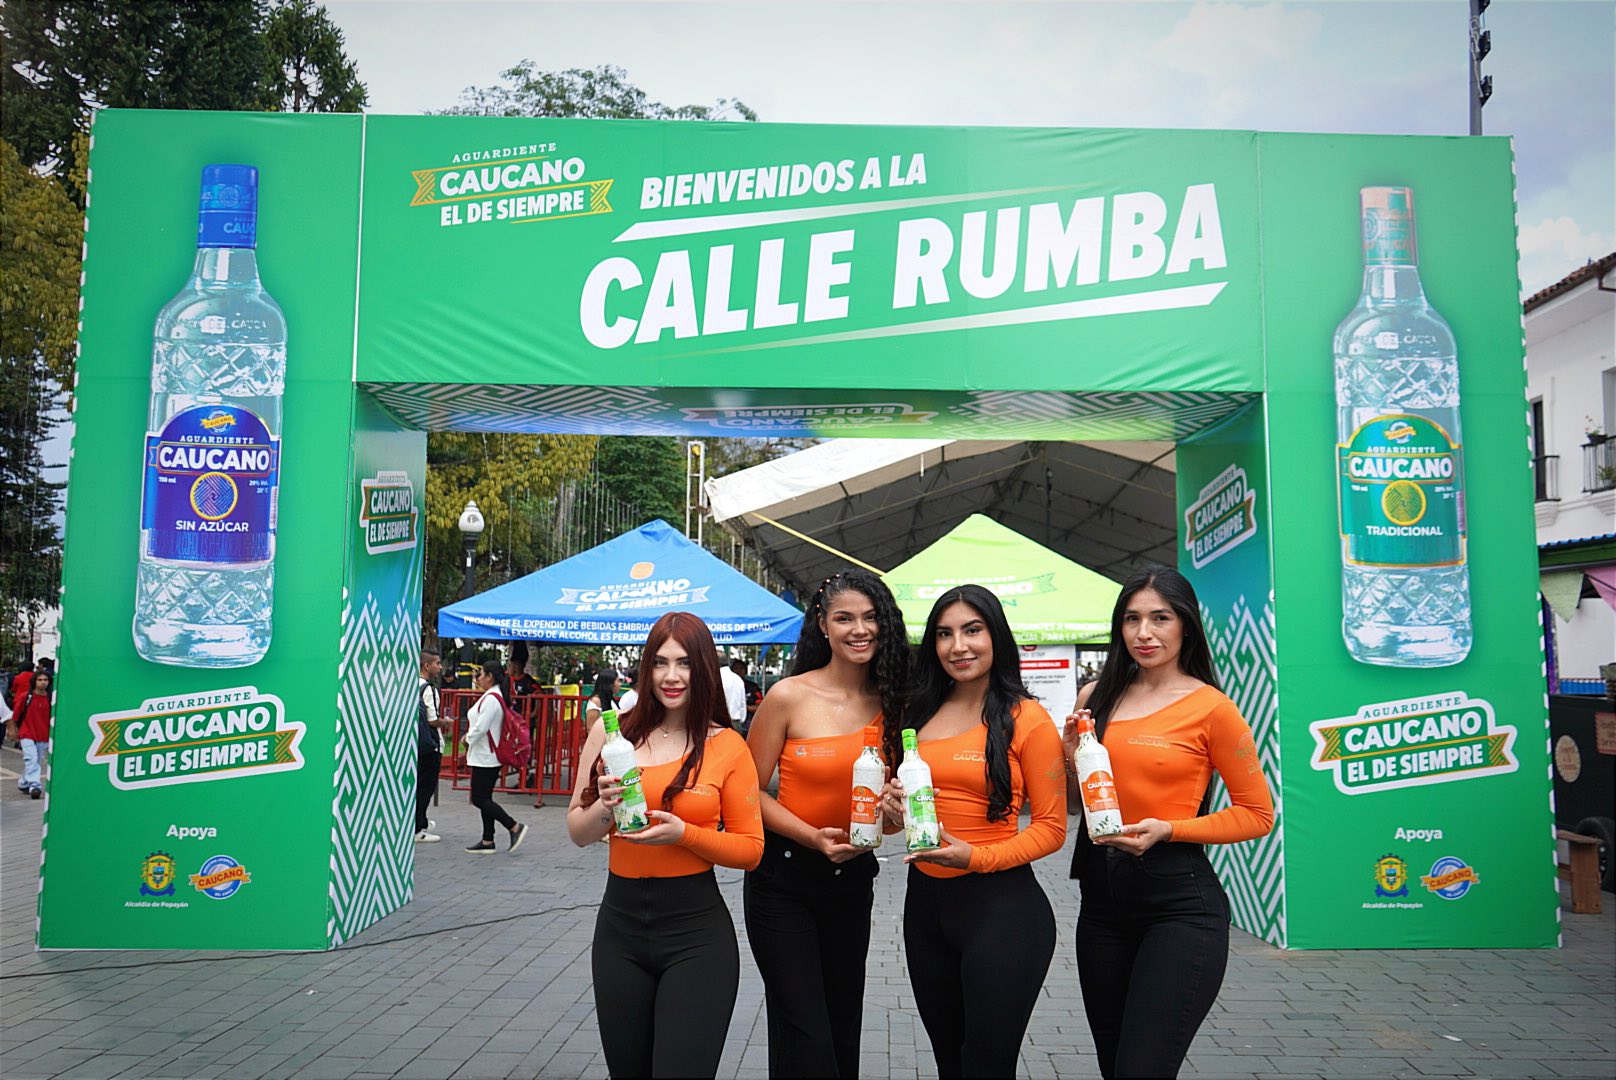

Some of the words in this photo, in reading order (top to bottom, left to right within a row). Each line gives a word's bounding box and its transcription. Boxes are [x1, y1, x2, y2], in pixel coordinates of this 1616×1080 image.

[452, 142, 557, 164] AGUARDIENTE
[440, 157, 586, 197] CAUCANO
[640, 159, 855, 210] BIENVENIDOS
[859, 156, 883, 191] A
[889, 153, 928, 186] LA
[440, 205, 463, 227] EL
[467, 201, 493, 224] DE
[496, 190, 585, 220] SIEMPRE
[580, 229, 856, 350] CALLE
[892, 183, 1228, 310] RUMBA
[726, 416, 894, 426] CAUCANO
[180, 435, 255, 445] AGUARDIENTE
[1367, 446, 1436, 454] AGUARDIENTE
[159, 446, 270, 471] CAUCANO
[1350, 457, 1454, 479] CAUCANO
[371, 490, 411, 514] CAUCANO
[1195, 480, 1243, 532] CAUCANO
[175, 520, 196, 531] SIN
[199, 519, 249, 532] AZÚCAR
[369, 523, 377, 543] EL
[377, 522, 386, 541] DE
[386, 519, 410, 540] SIEMPRE
[1196, 539, 1205, 559] EL
[1204, 534, 1213, 555] DE
[1213, 511, 1244, 547] SIEMPRE
[1366, 525, 1443, 537] TRADICIONAL
[500, 628, 509, 637] EL
[511, 629, 544, 638] EXCESO
[545, 630, 557, 639] DE
[558, 631, 599, 641] ALCOHOL
[600, 632, 611, 641] ES
[612, 632, 649, 642] PERJUDI
[512, 619, 522, 628] EL
[524, 620, 566, 629] EXPENDIO
[567, 621, 579, 630] DE
[580, 621, 617, 631] BEBIDAS
[146, 691, 252, 713] AGUARDIENTE
[1363, 697, 1462, 719] AGUARDIENTE
[124, 706, 271, 747] CAUCANO
[1344, 711, 1482, 753] CAUCANO
[123, 757, 145, 778] EL
[150, 752, 176, 775] DE
[179, 740, 269, 771] SIEMPRE
[1347, 762, 1369, 783] EL
[1372, 757, 1397, 780] DE
[1400, 743, 1483, 776] SIEMPRE
[166, 824, 217, 840] Apoya
[1394, 827, 1443, 843] Apoya
[198, 869, 243, 887] CAUCANO
[1429, 870, 1471, 888] CAUCANO
